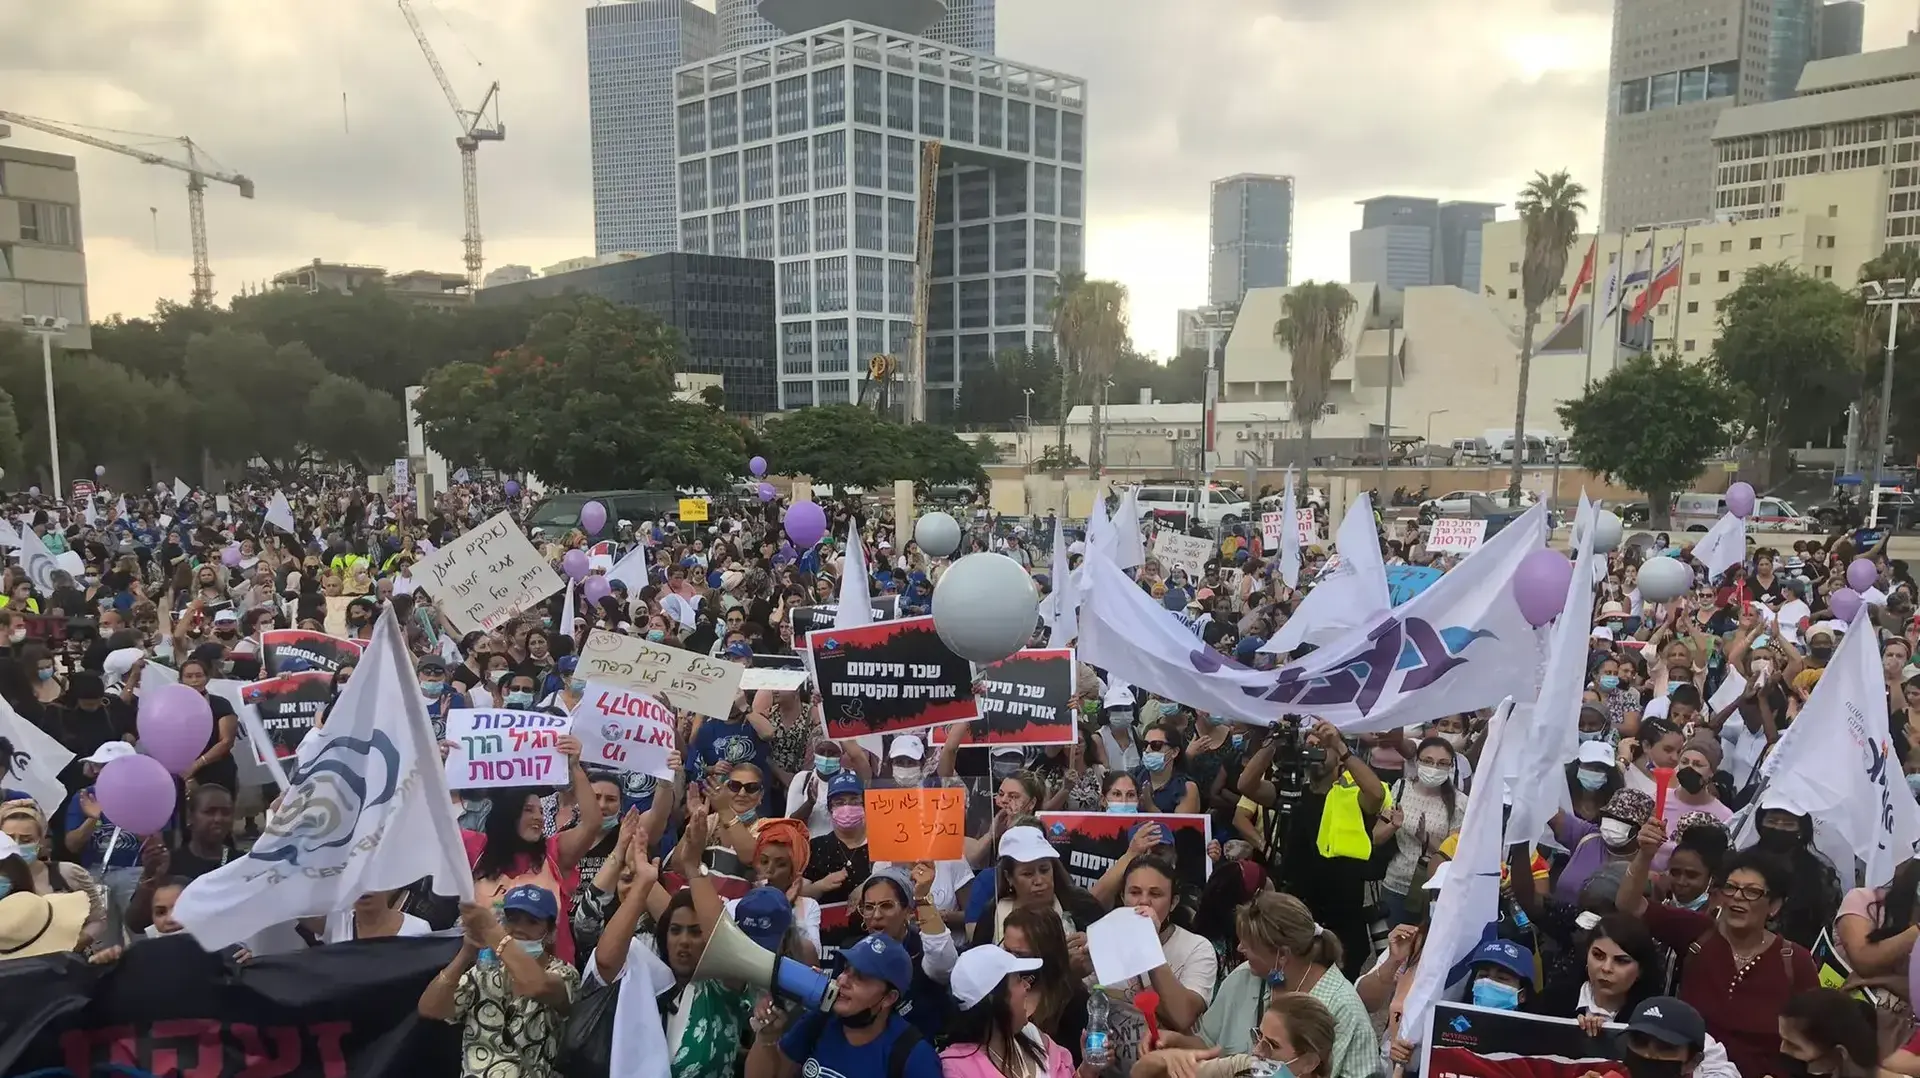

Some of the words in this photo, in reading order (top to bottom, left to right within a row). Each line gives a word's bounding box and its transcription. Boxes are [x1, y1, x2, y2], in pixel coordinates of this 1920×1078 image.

[466, 521, 508, 556] נאבקים
[1431, 536, 1477, 548] קורסות
[432, 550, 457, 587] למען
[466, 602, 484, 623] הרך
[635, 646, 671, 664] הרך
[642, 669, 667, 683] לא
[687, 657, 725, 678] הגיל
[847, 661, 906, 679] מינימום
[910, 664, 941, 679] שכר
[671, 678, 697, 692] הוא
[831, 682, 899, 700] מקסימום
[902, 683, 956, 699] אחריות
[1017, 684, 1045, 699] שכר
[280, 702, 296, 714] את
[1007, 701, 1057, 720] אחריות
[472, 714, 566, 730] מחנכות
[461, 735, 503, 760] הרך
[509, 728, 559, 752] הגיל
[602, 742, 627, 762] מי
[469, 755, 552, 781] קורסות
[900, 793, 918, 809] לא
[932, 793, 960, 810] ילד
[894, 822, 909, 843] 3
